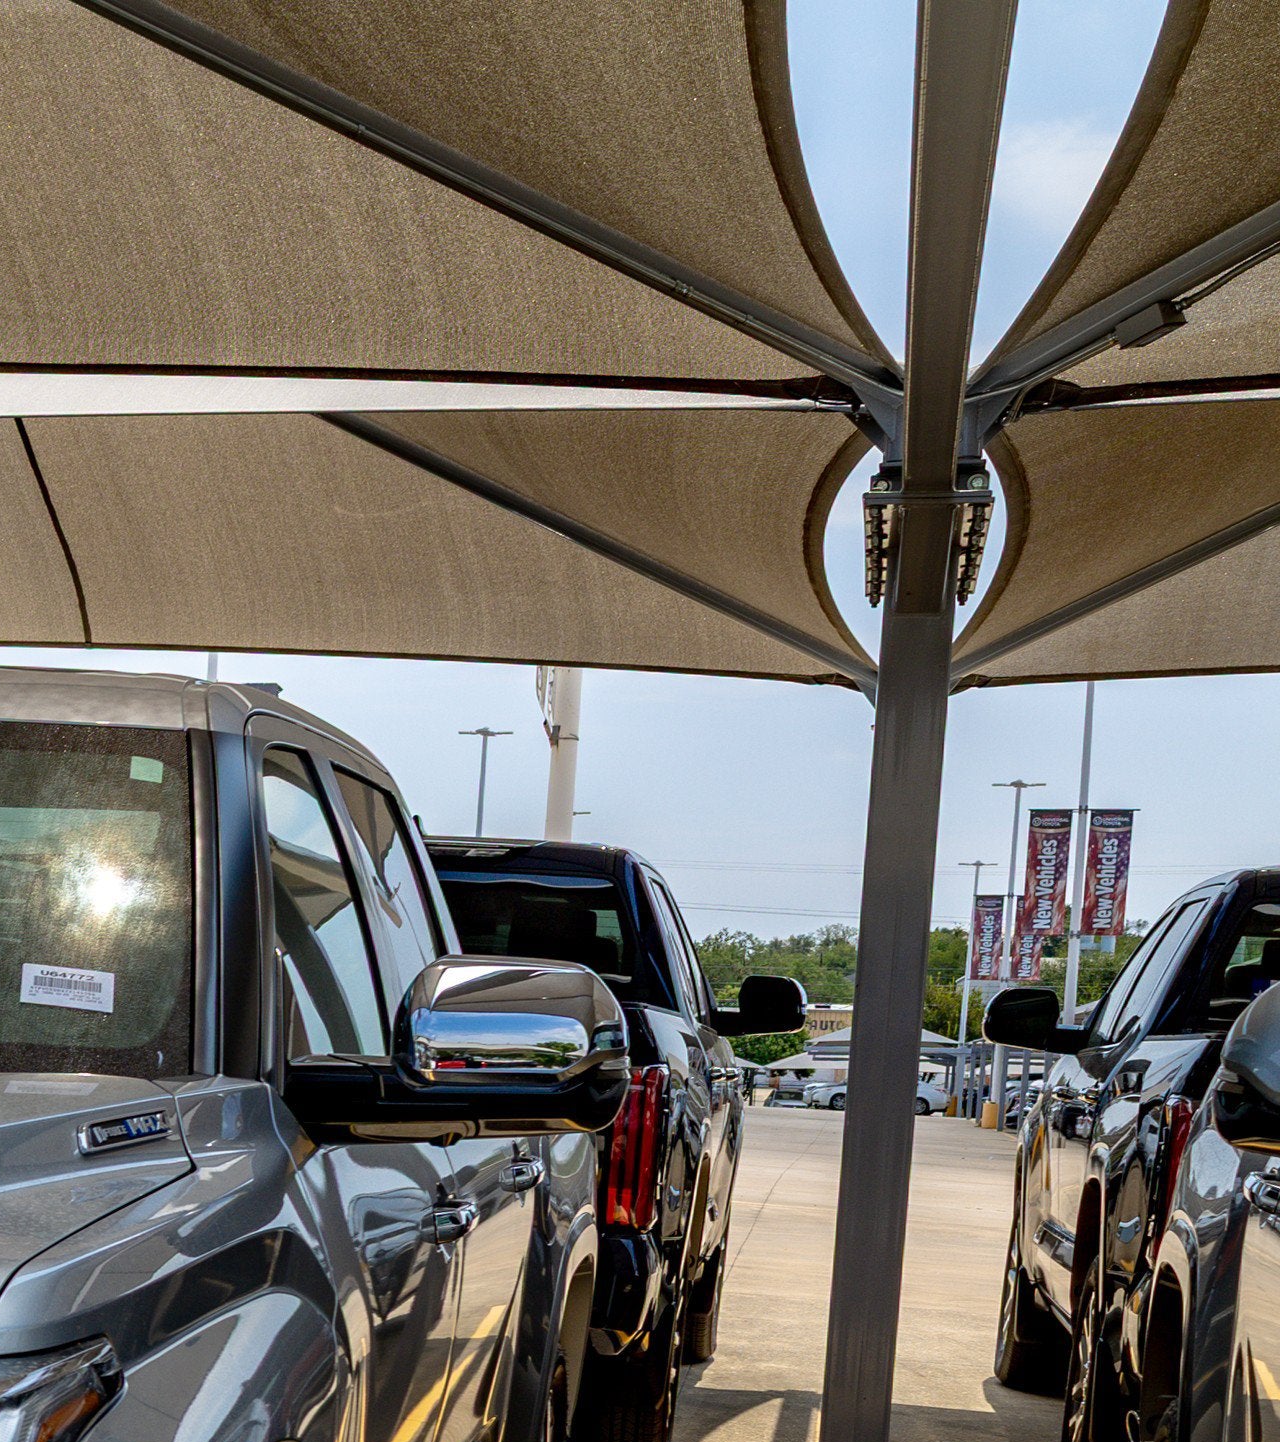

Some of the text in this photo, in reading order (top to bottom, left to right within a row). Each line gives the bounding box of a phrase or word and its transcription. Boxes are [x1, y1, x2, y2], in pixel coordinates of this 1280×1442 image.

[1035, 839, 1058, 897] Vehicles
[1095, 838, 1119, 896] Vehicles
[1032, 898, 1053, 929] New
[1092, 897, 1114, 929] New
[979, 915, 995, 954] Vehicles
[40, 969, 95, 982] U64772
[977, 955, 992, 976] New
[1017, 956, 1032, 977] New
